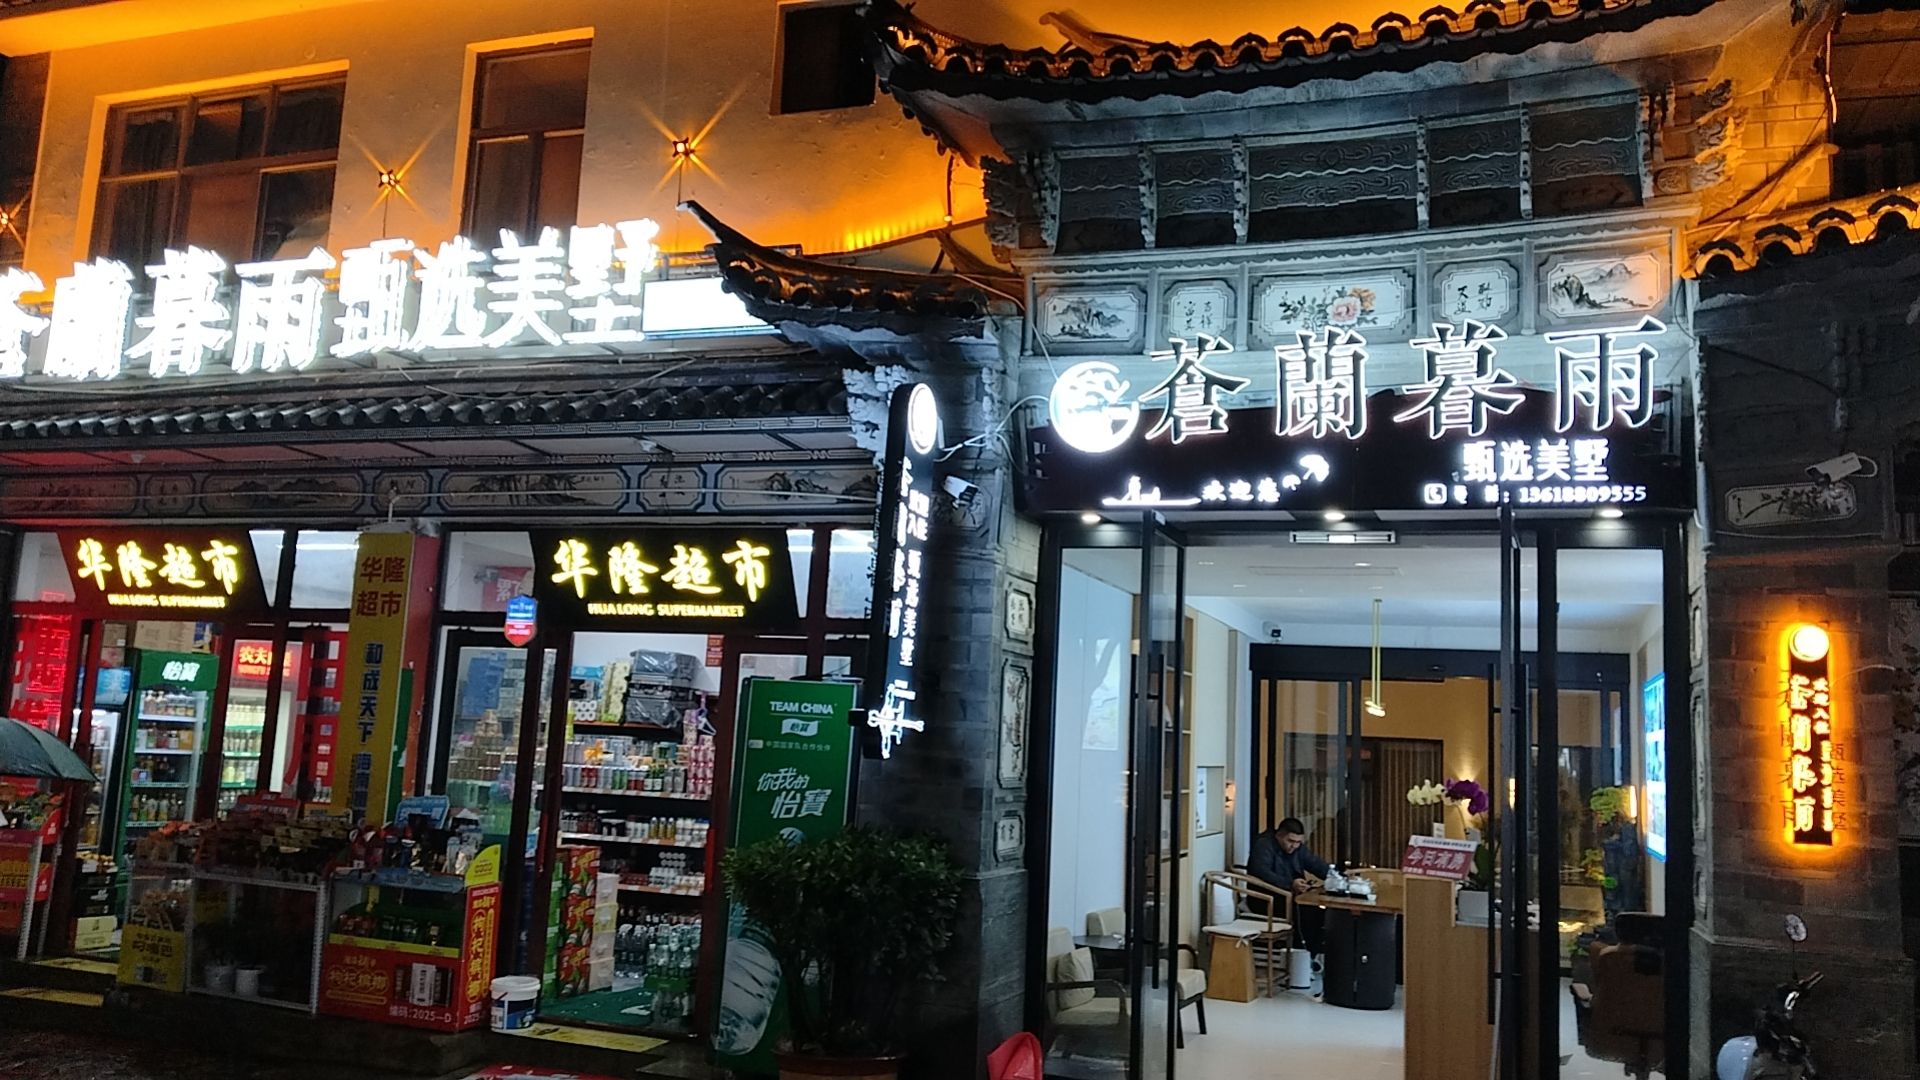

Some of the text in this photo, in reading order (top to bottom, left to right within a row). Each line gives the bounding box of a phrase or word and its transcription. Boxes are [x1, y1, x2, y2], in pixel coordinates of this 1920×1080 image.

[76, 537, 241, 596] 华隆超市
[359, 556, 406, 584] 华隆
[551, 538, 771, 603] 华隆超市
[355, 590, 403, 618] 超市
[656, 604, 746, 618] SUPERMARKET
[769, 701, 834, 715] TEAM CHINA
[756, 767, 810, 791] 你我的
